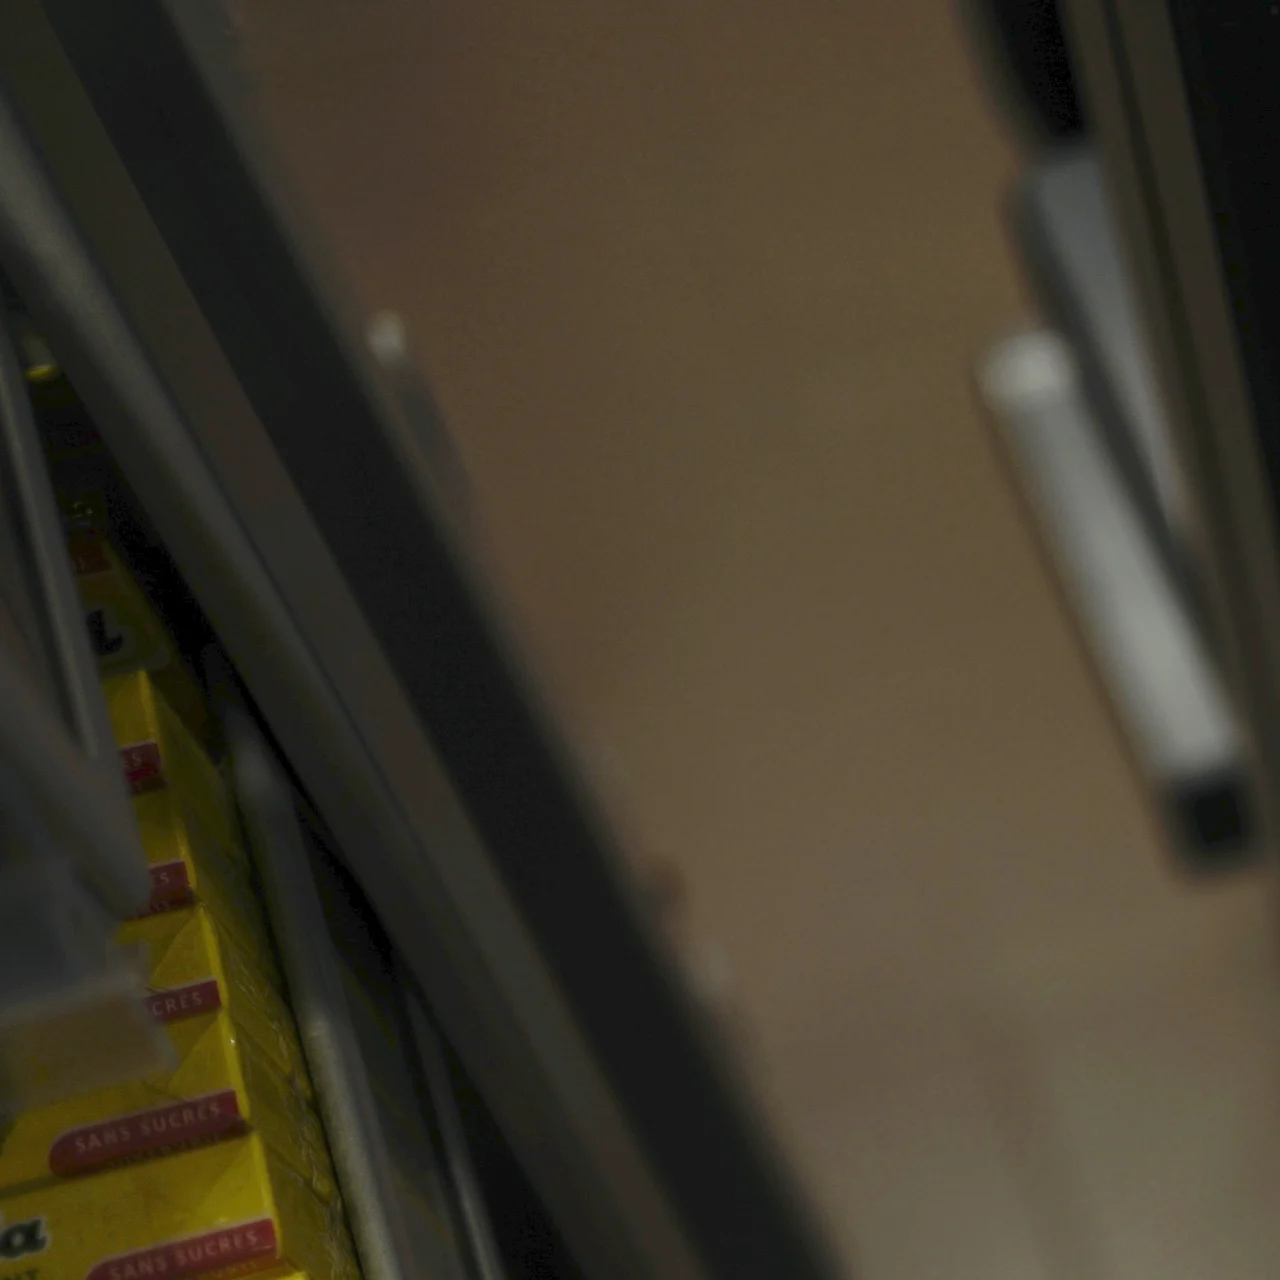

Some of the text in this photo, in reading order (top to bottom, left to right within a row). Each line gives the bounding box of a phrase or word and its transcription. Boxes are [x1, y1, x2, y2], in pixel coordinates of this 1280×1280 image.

[75, 1125, 131, 1154] SANS
[140, 1102, 221, 1137] SUCRES
[174, 1230, 259, 1266] SUCRES
